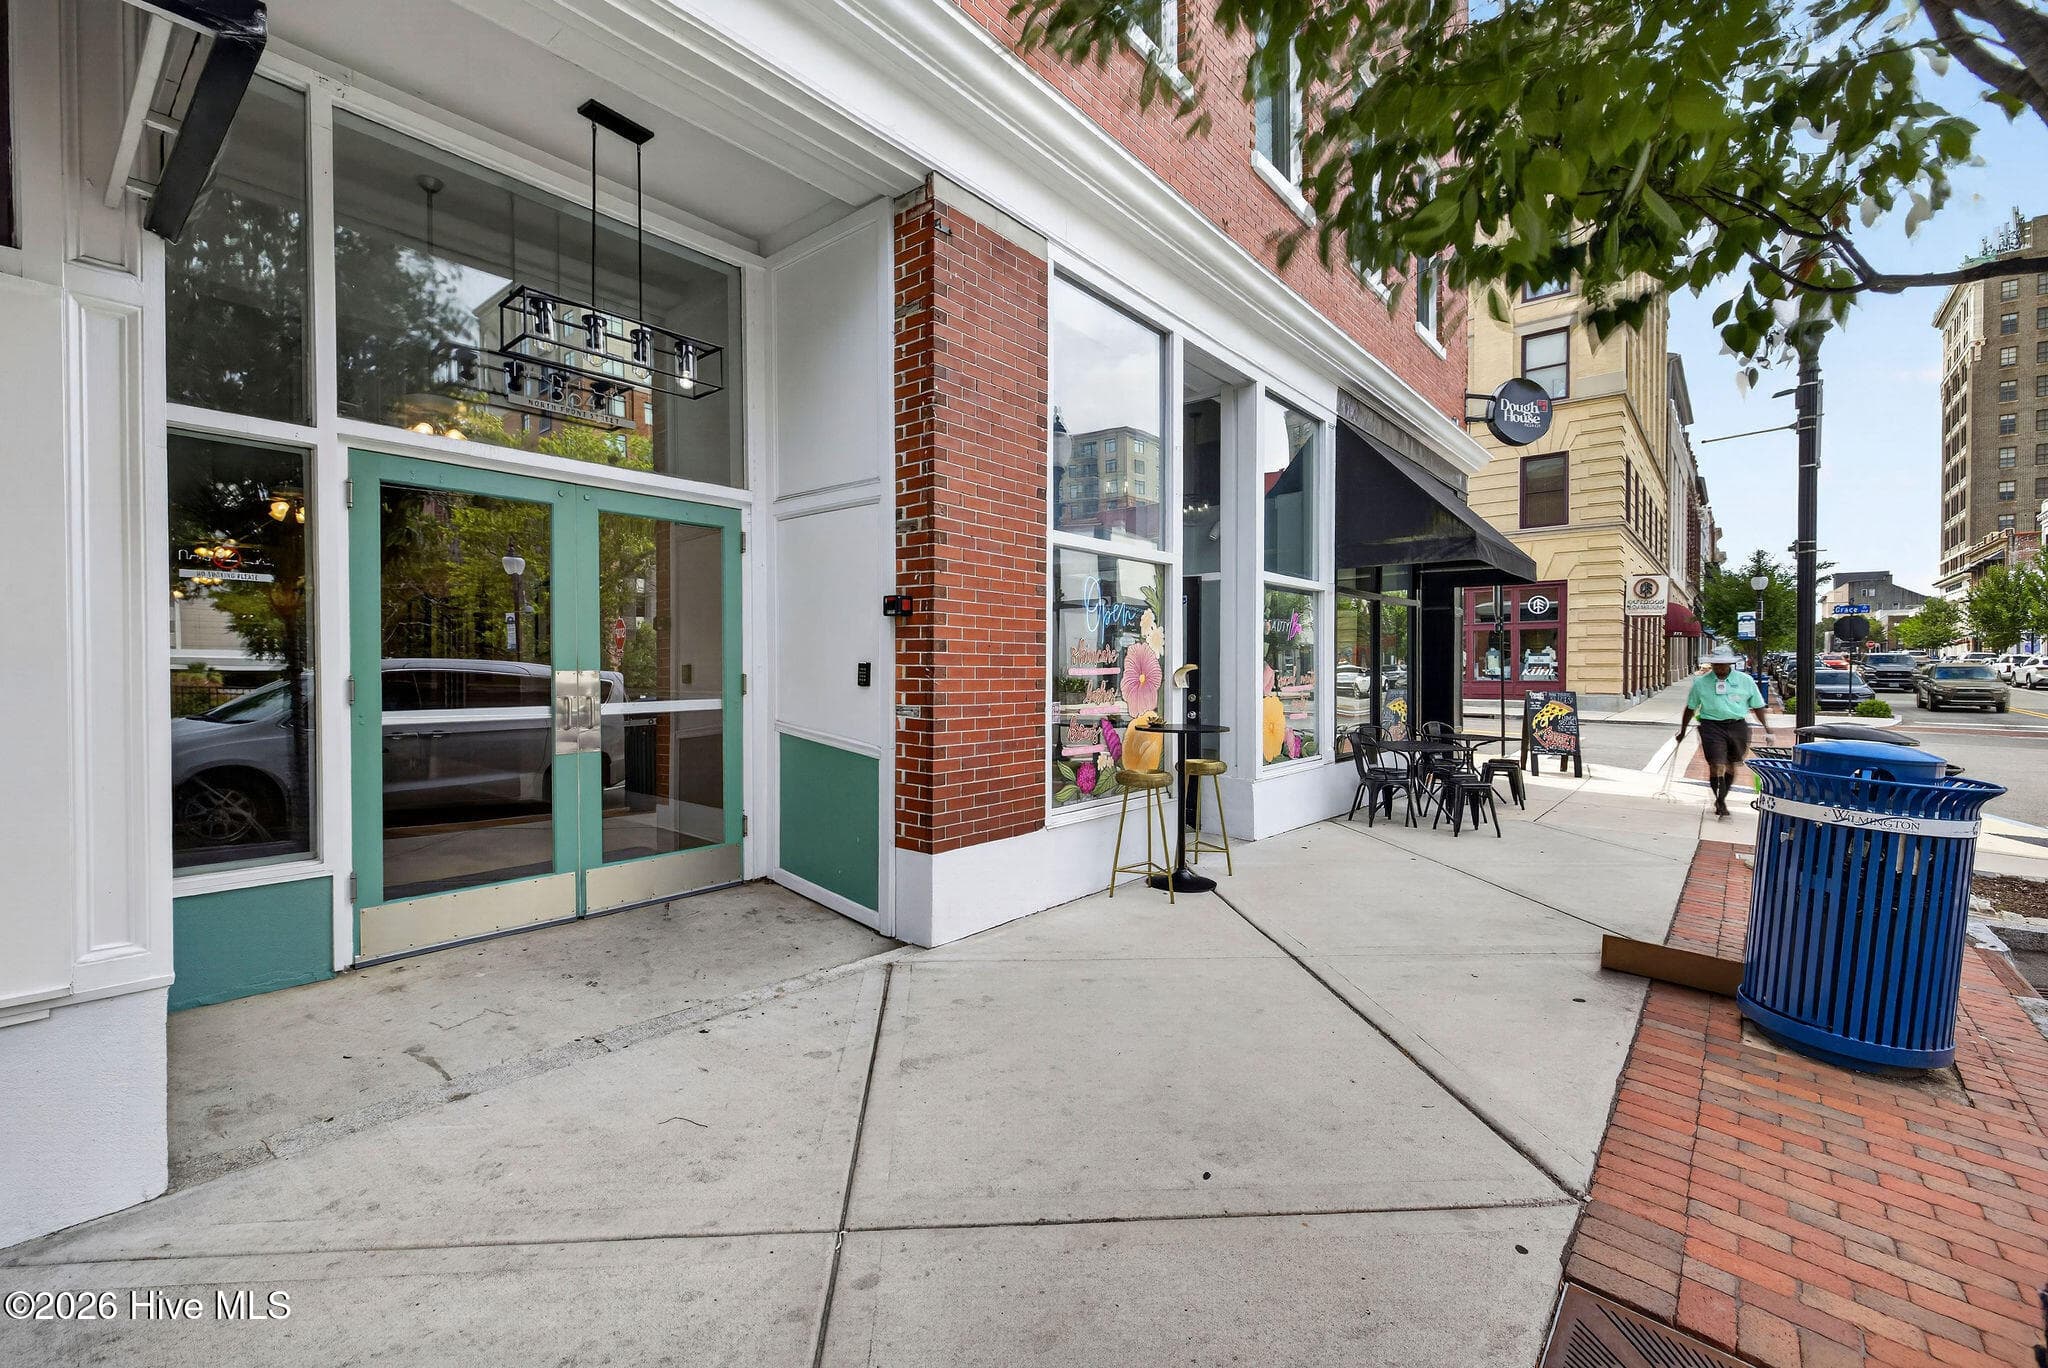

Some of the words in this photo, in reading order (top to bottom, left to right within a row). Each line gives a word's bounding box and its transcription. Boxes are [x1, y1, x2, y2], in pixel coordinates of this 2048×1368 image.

[1500, 398, 1540, 414] Dough
[1504, 409, 1541, 424] House
[1083, 575, 1136, 644] Open
[1835, 606, 1858, 614] Grace
[1832, 808, 1920, 831] WILMINGTON
